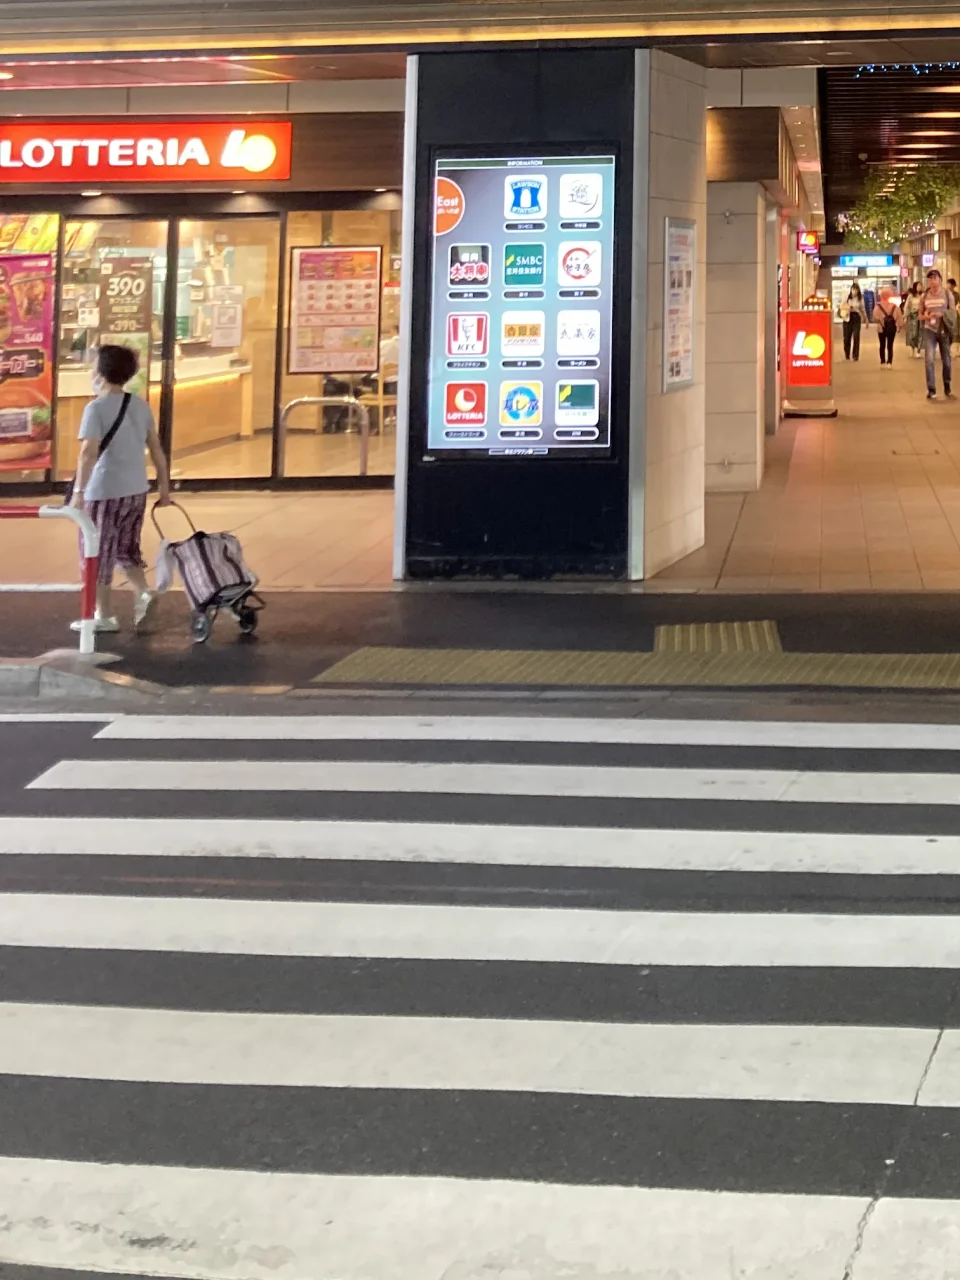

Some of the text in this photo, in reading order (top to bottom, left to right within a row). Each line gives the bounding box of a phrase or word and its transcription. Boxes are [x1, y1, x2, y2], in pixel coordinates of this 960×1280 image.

[0, 138, 210, 168] LOTTERIA
[511, 180, 541, 189] LAWSON
[437, 196, 460, 207] East
[516, 255, 543, 265] SMBC
[106, 276, 146, 296] 390
[457, 343, 476, 351] KFC
[792, 359, 824, 367] LOTTERIA
[447, 411, 484, 420] LOTTERIA
